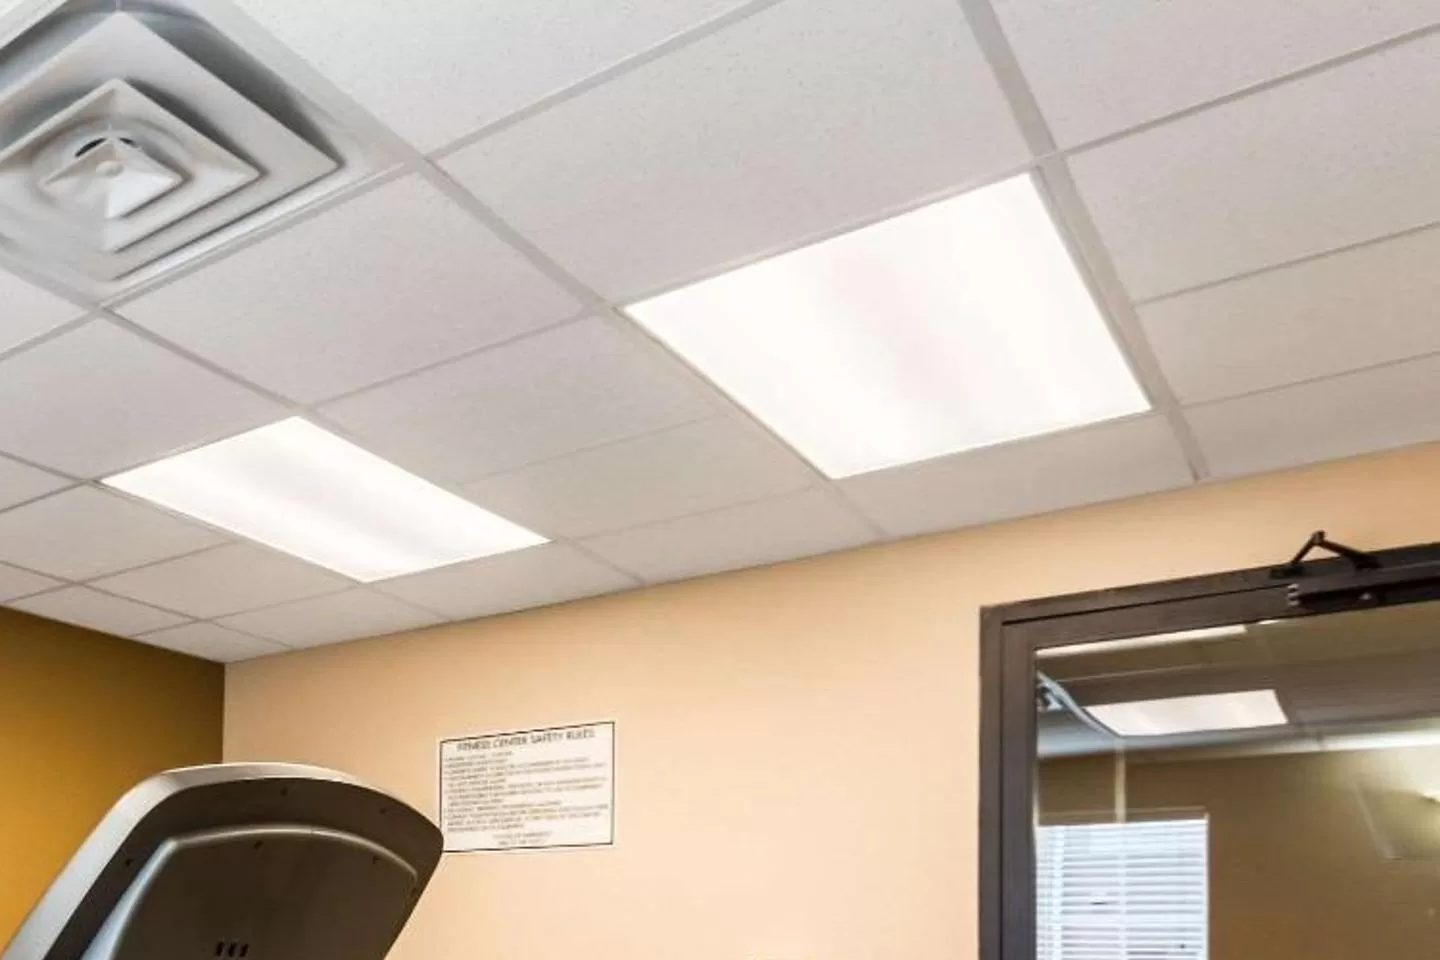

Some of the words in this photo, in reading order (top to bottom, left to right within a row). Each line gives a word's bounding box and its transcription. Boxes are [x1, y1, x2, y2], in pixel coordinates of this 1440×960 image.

[492, 735, 527, 748] CENTER
[530, 730, 564, 745] SAFETY
[566, 728, 595, 741] RULES
